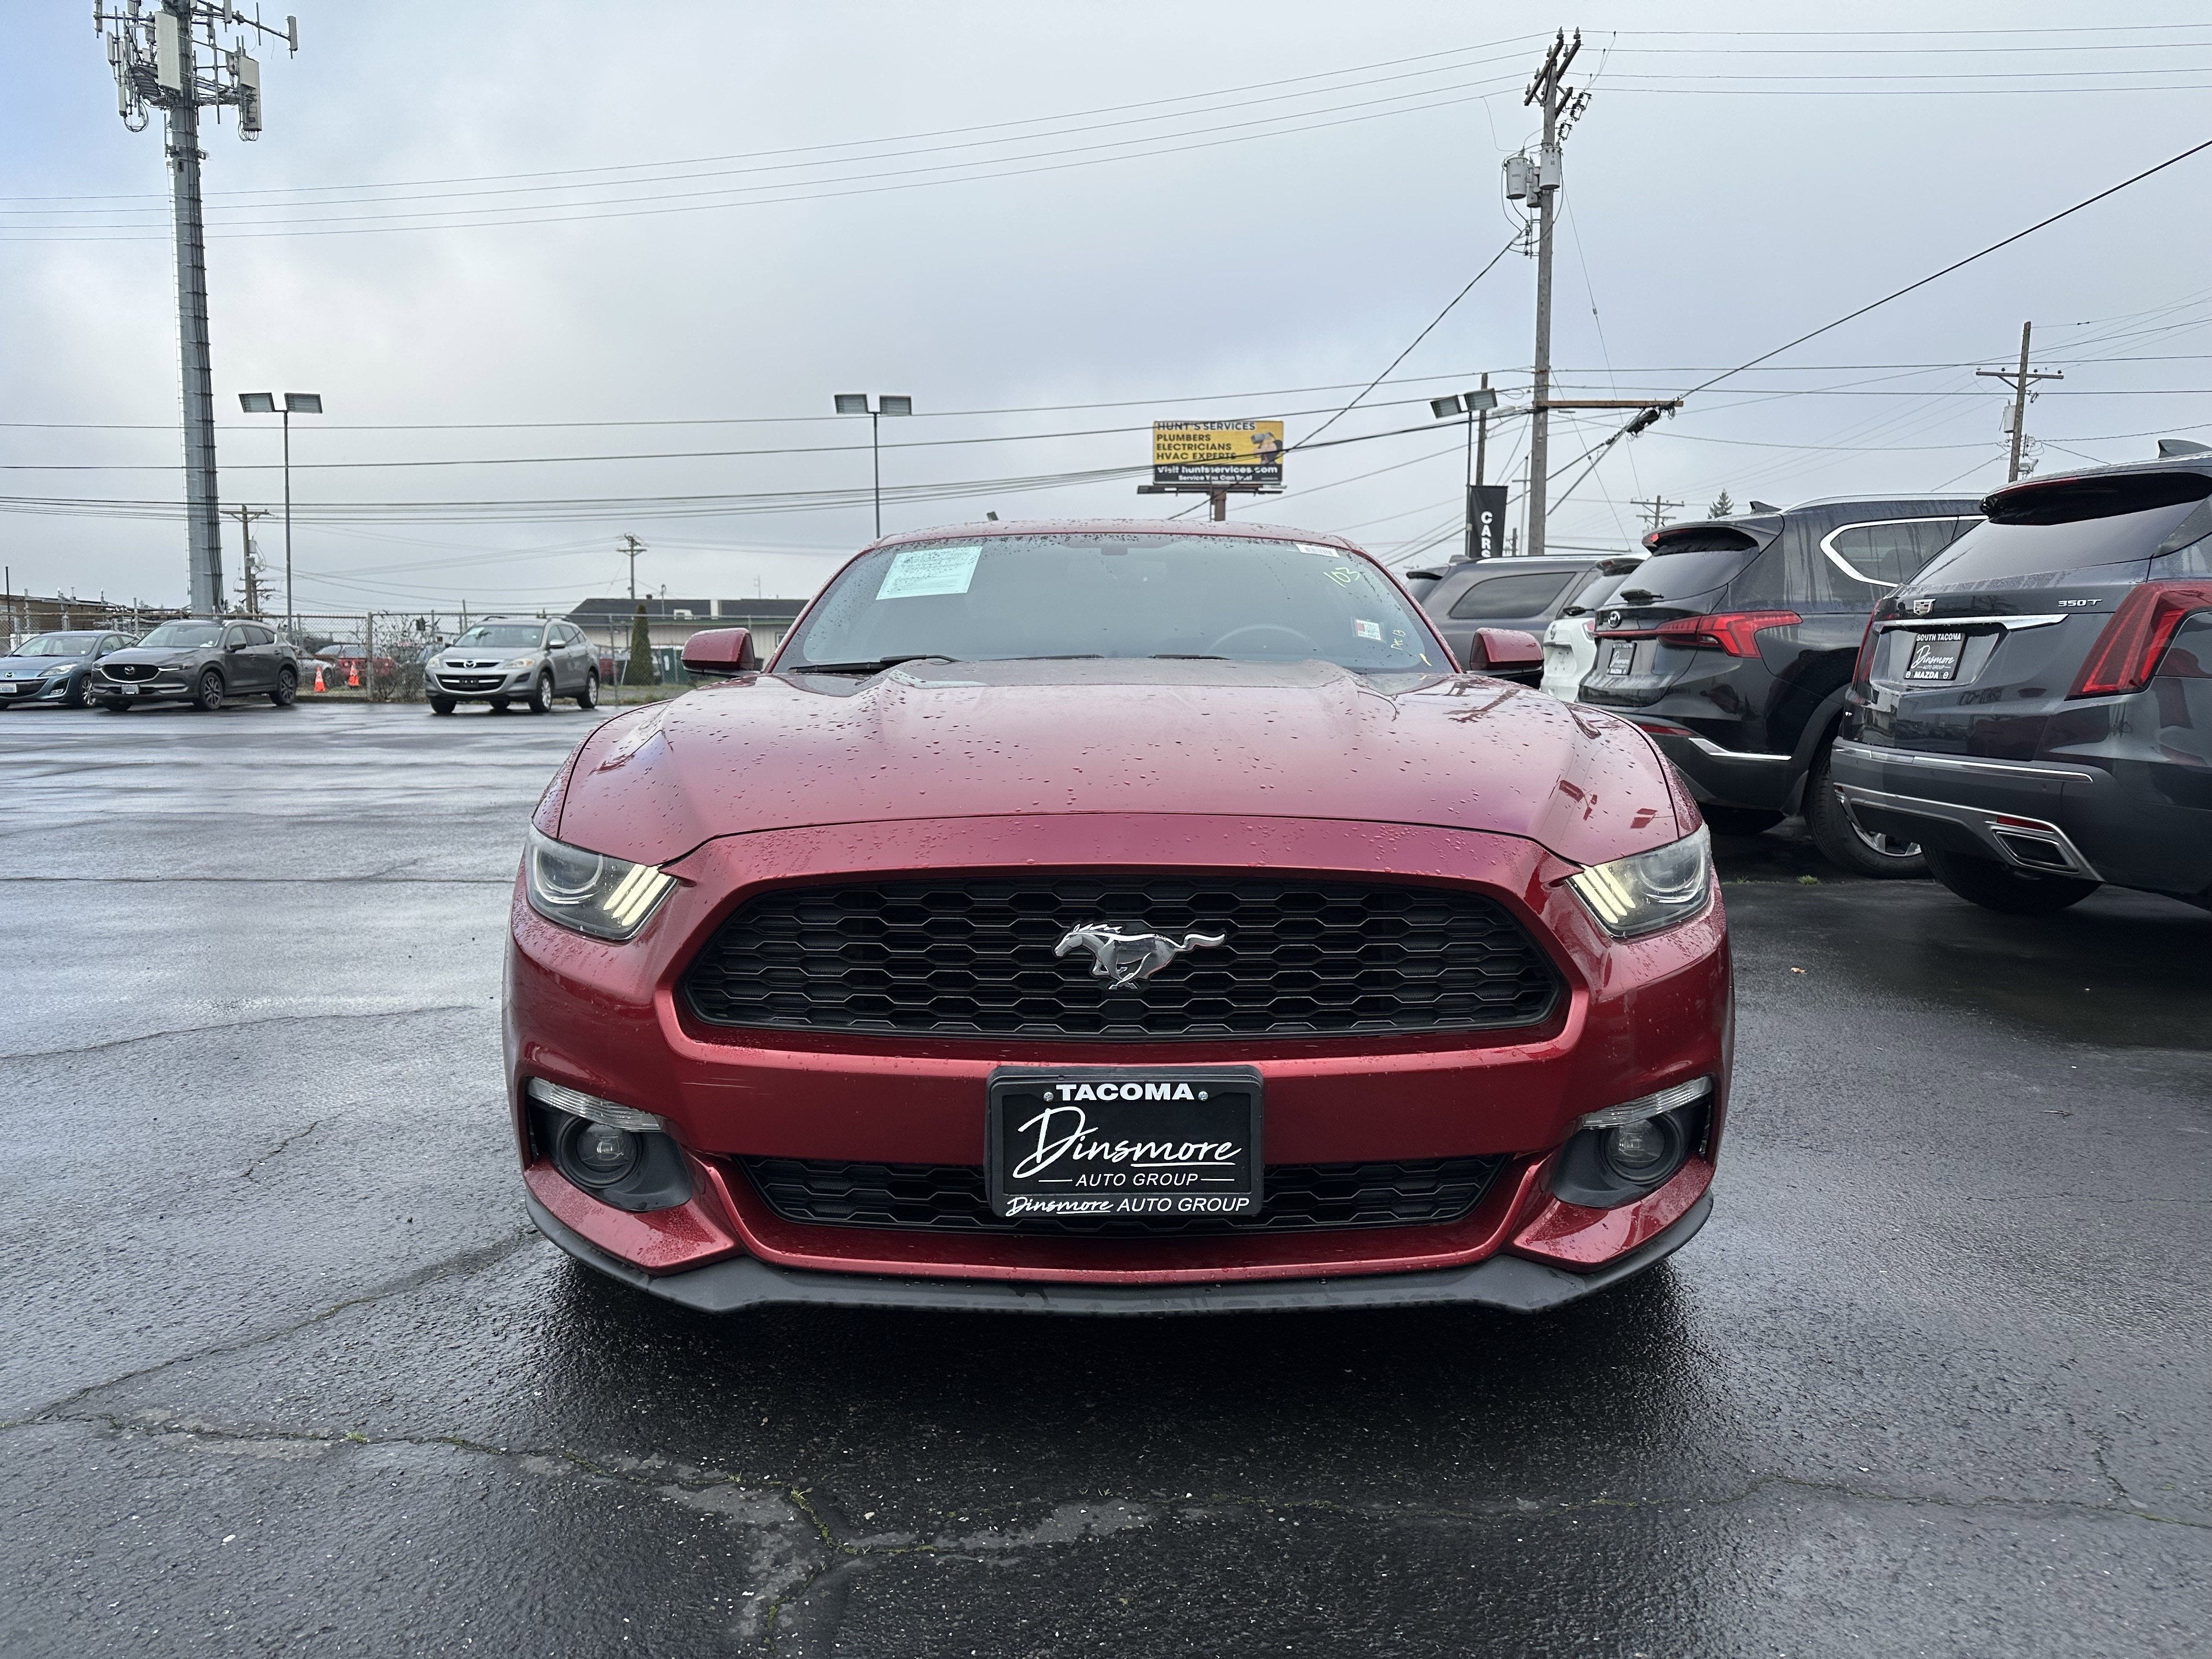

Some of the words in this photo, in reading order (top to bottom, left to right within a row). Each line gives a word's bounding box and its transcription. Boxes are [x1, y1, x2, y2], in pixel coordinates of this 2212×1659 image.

[1204, 421, 1255, 431] SERVICES
[1911, 645, 1955, 669] Dinsmore
[1914, 671, 1939, 679] MAZDA
[1056, 1083, 1195, 1101] TACOMA
[1012, 1106, 1242, 1178] Dinsmore
[1075, 1173, 1126, 1187] AUTO
[1133, 1173, 1198, 1186] GROUP
[1005, 1196, 1114, 1217] Dinsmore
[1116, 1198, 1172, 1212] AUTO
[1177, 1198, 1250, 1212] GROUP
